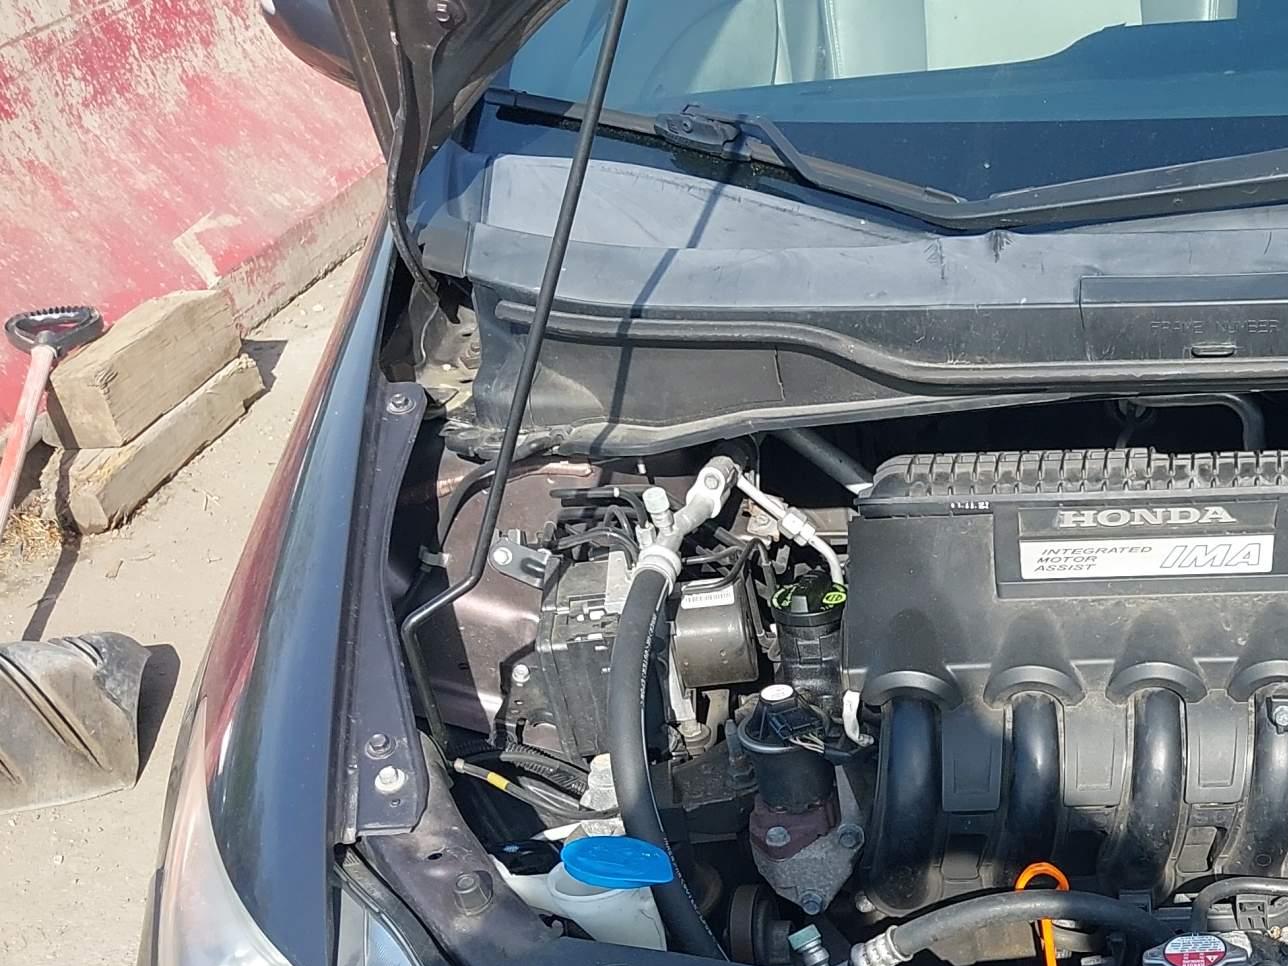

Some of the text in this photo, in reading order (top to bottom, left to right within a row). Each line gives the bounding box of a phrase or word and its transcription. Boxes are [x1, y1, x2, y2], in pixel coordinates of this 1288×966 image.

[1151, 319, 1279, 334] FRAME NUMBER
[1059, 506, 1236, 528] HONDA
[1041, 546, 1152, 556] INTEGRATED
[1160, 543, 1262, 568] IMA
[1036, 555, 1097, 563] MOTOR
[1034, 563, 1096, 572] ASSIST
